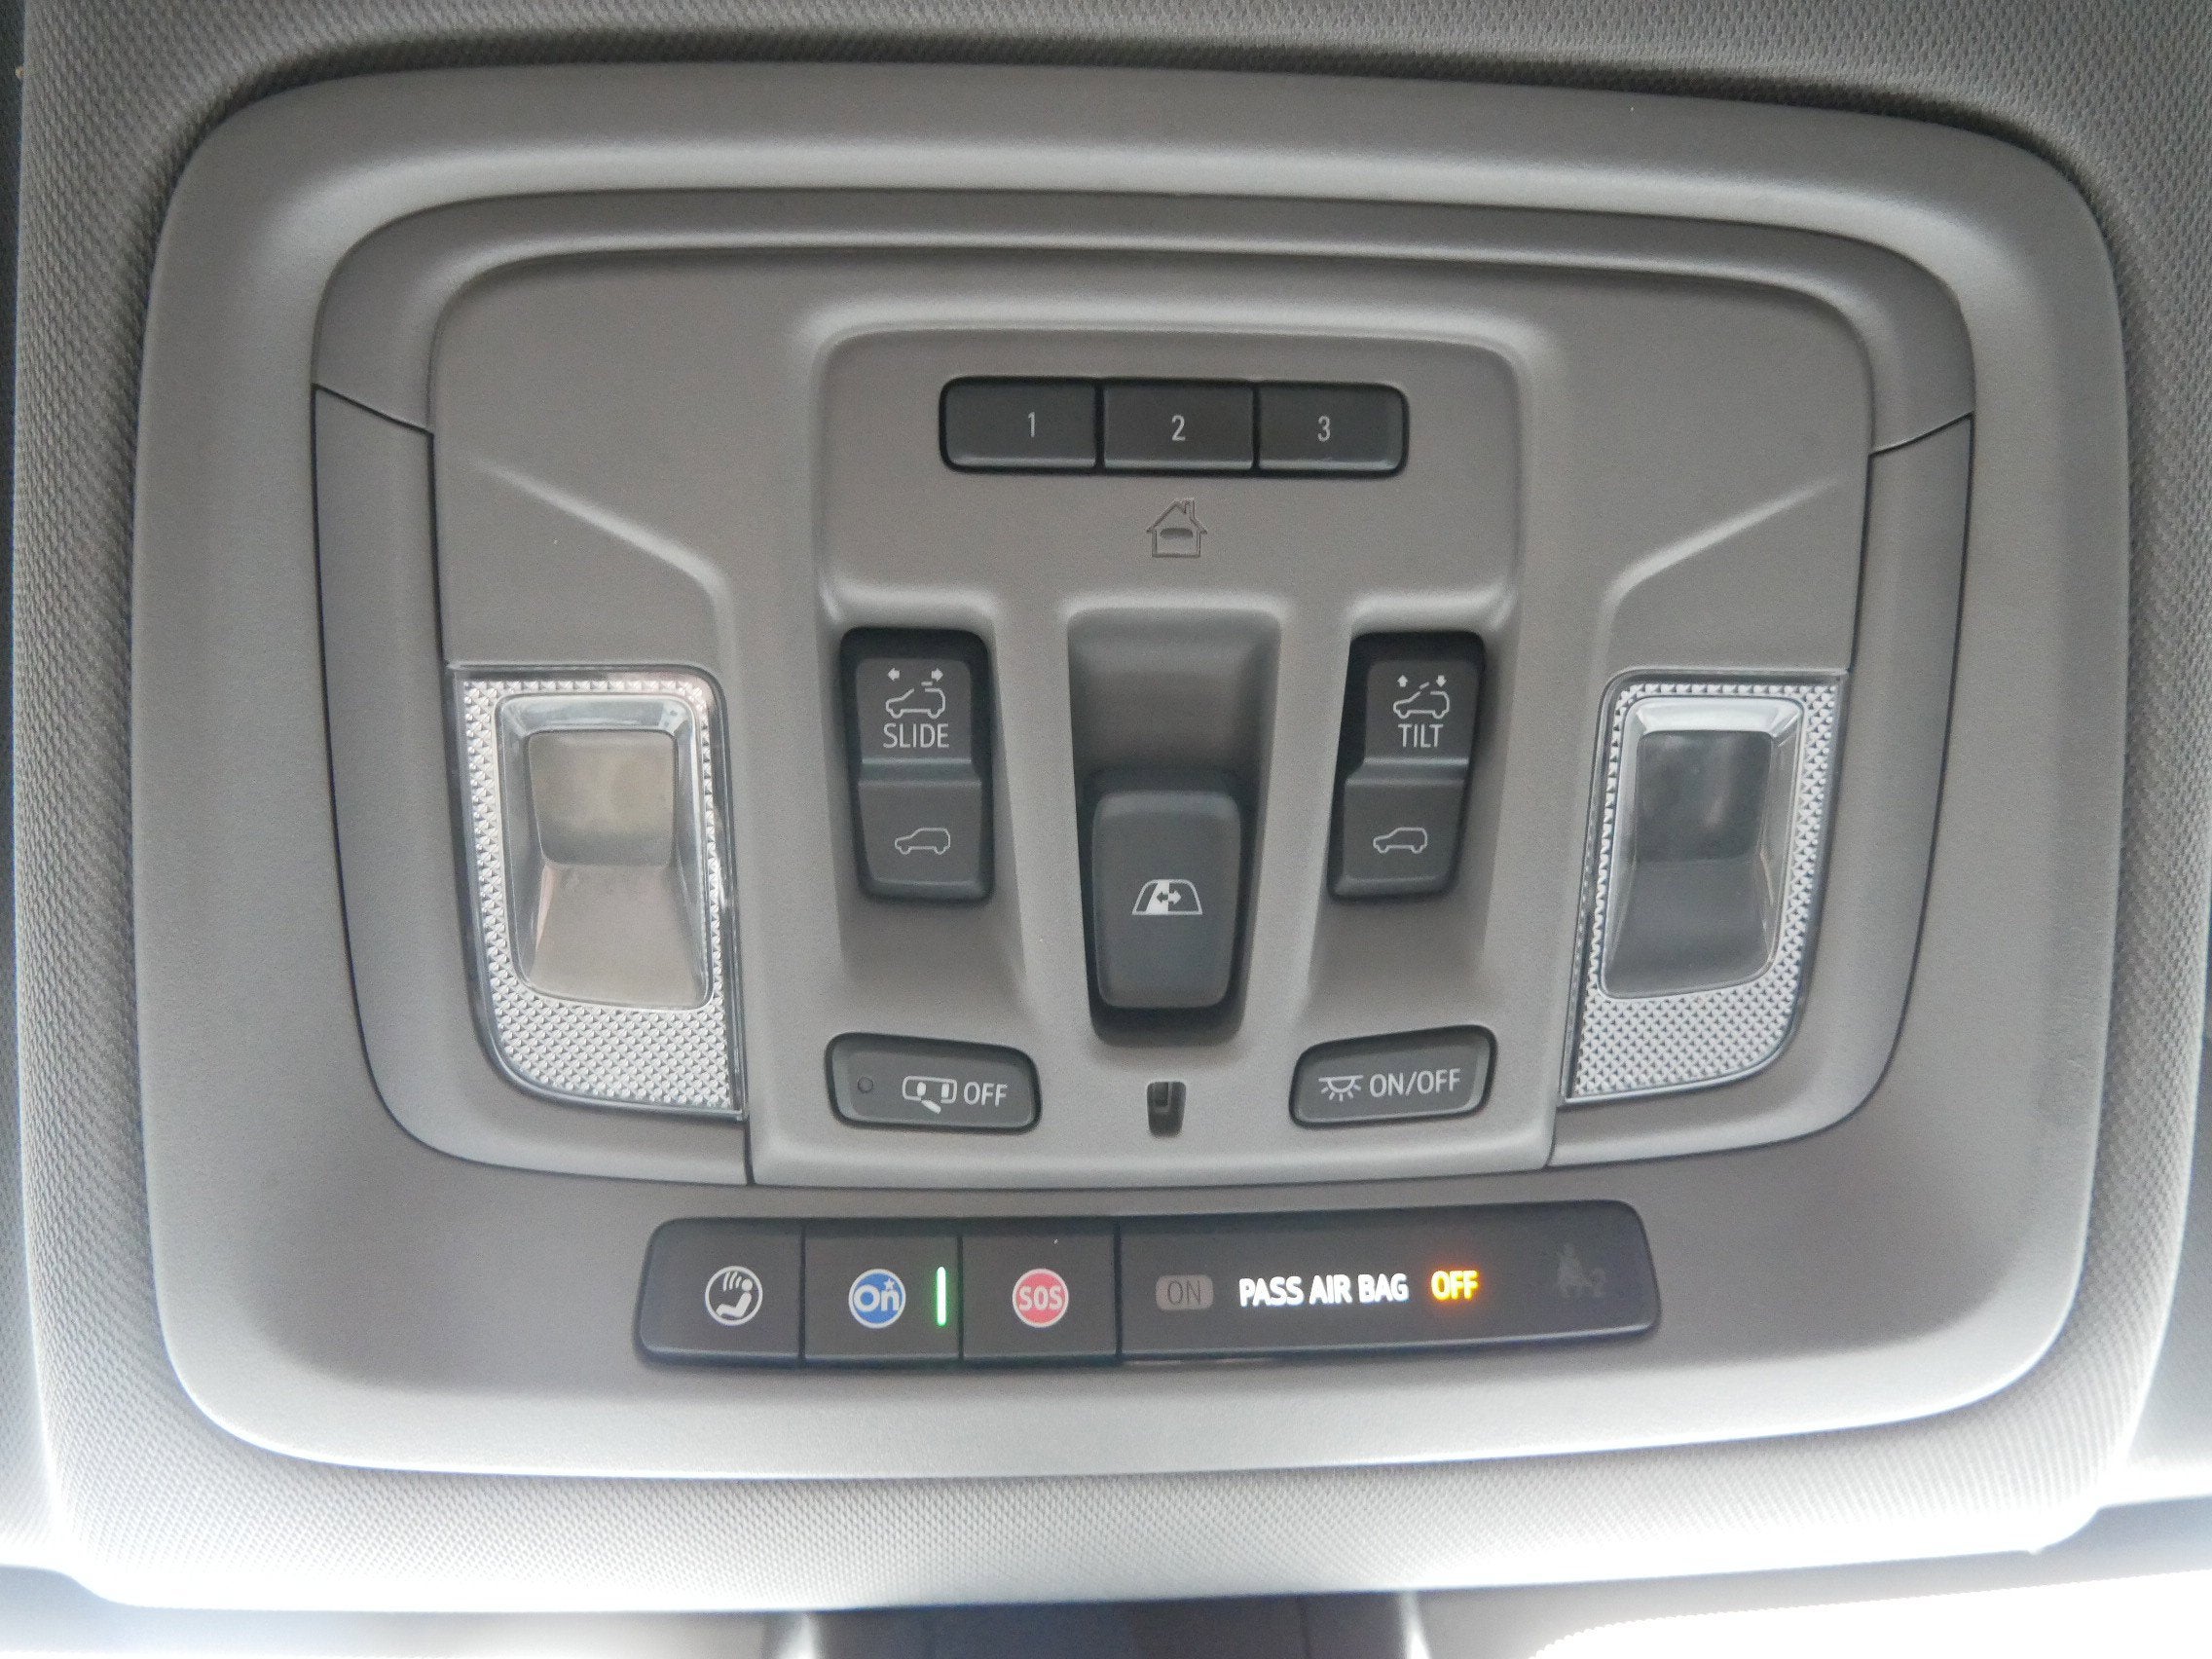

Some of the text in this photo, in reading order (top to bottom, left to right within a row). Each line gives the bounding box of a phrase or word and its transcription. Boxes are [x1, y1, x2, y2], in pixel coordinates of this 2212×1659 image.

[1026, 411, 1037, 439] 1
[1170, 414, 1187, 442] 2
[1316, 415, 1333, 442] 3
[882, 722, 950, 749] SLIDE
[1397, 723, 1444, 749] TILT
[963, 1081, 1009, 1107] OFF
[1369, 1068, 1461, 1098] ON/OFF
[852, 1282, 901, 1313] On
[1017, 1283, 1064, 1311] SOS
[1165, 1270, 1480, 1308] ON PASS AIR BAG OFF
